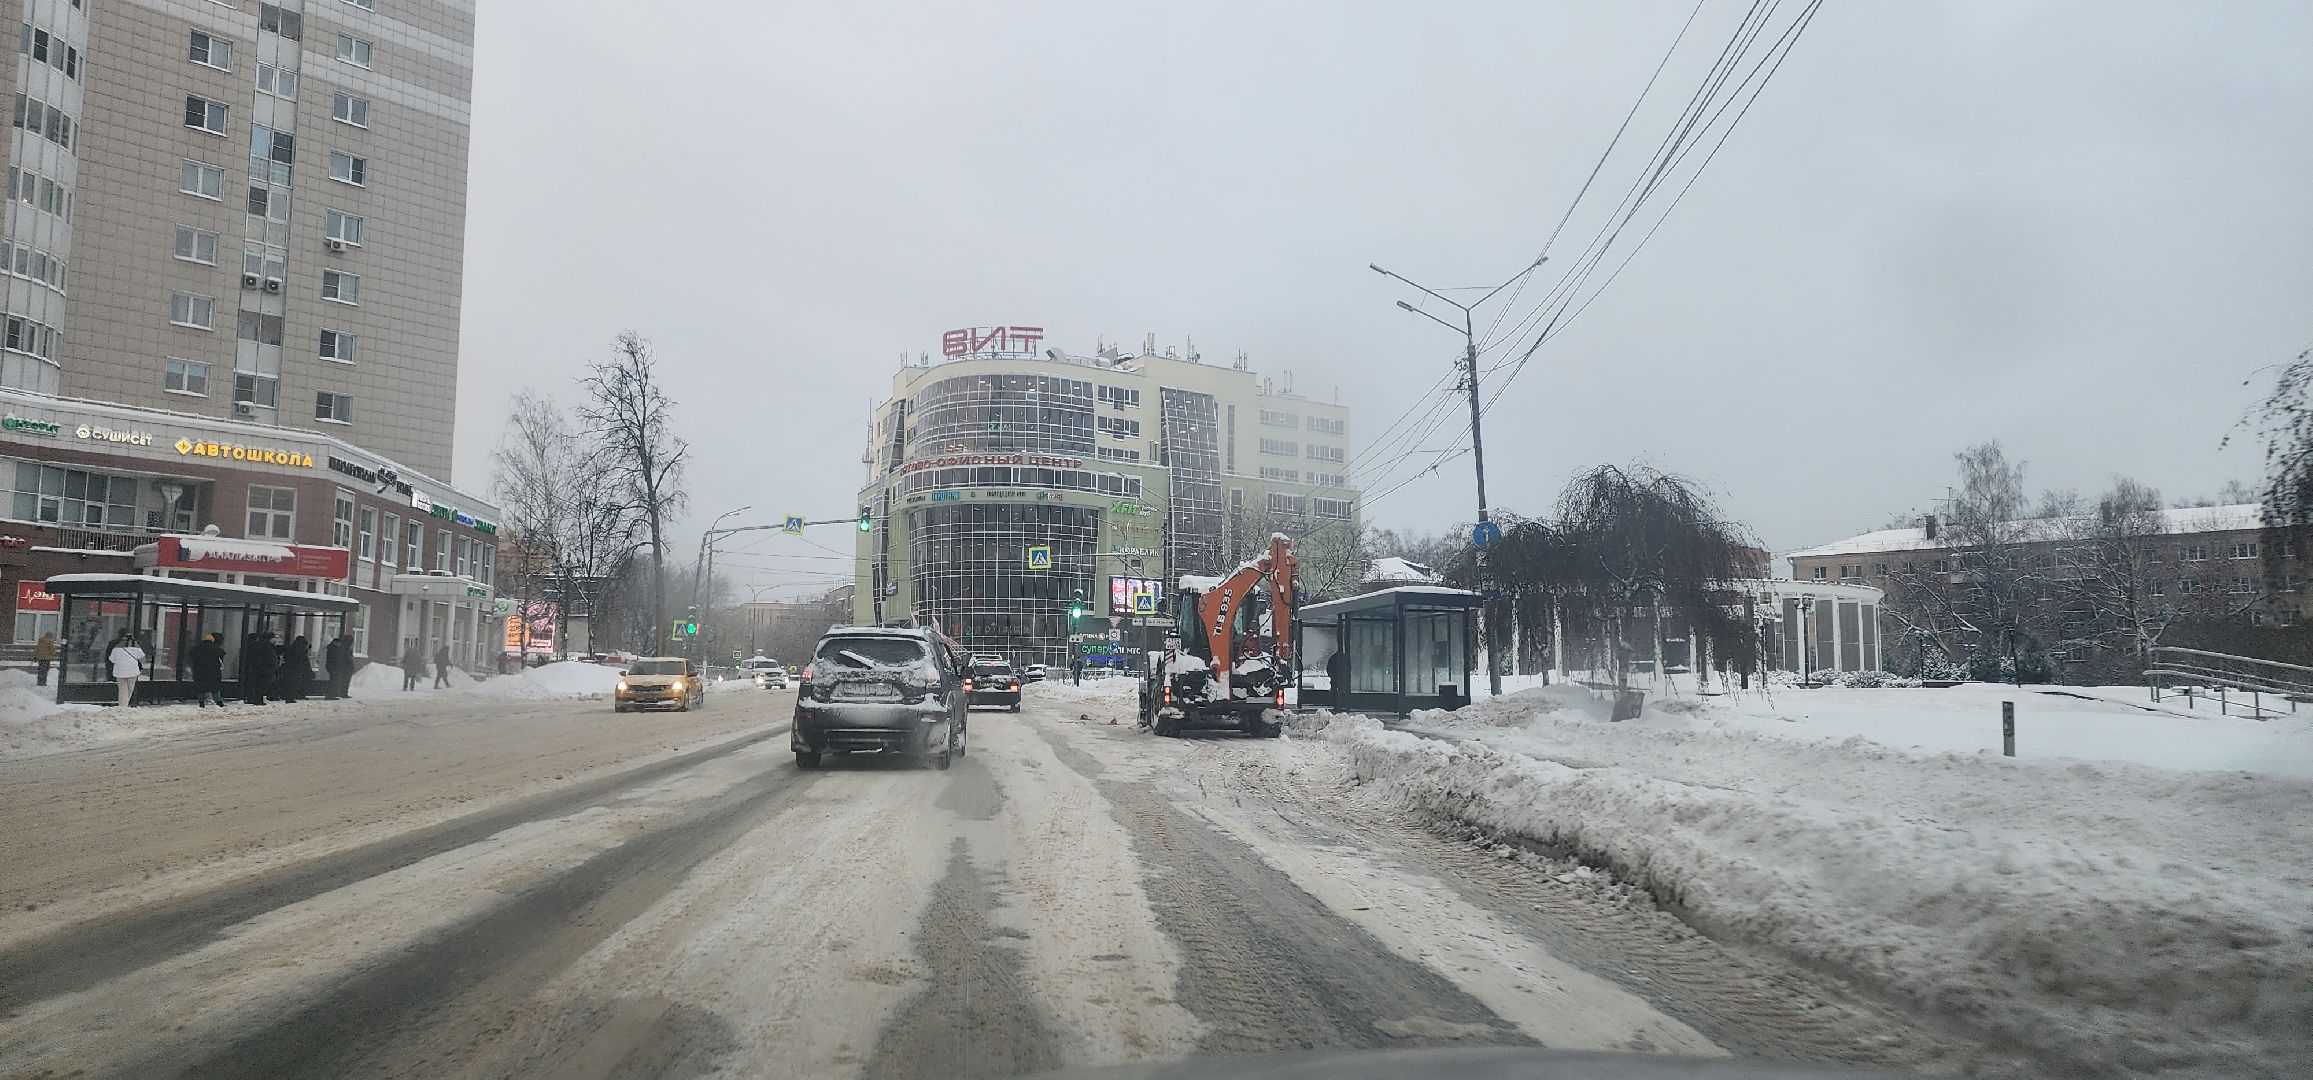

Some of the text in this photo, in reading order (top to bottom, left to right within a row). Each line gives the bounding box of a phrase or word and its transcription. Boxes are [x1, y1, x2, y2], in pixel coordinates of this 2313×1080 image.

[943, 326, 1043, 356] ВИТ
[92, 428, 153, 446] СУШИСЕТ
[192, 442, 315, 468] АВТОШКОЛА
[899, 454, 1083, 476] ОРГОВО-ОФИСНЫЙ ЦЕНТР
[1213, 614, 1226, 637] TLB
